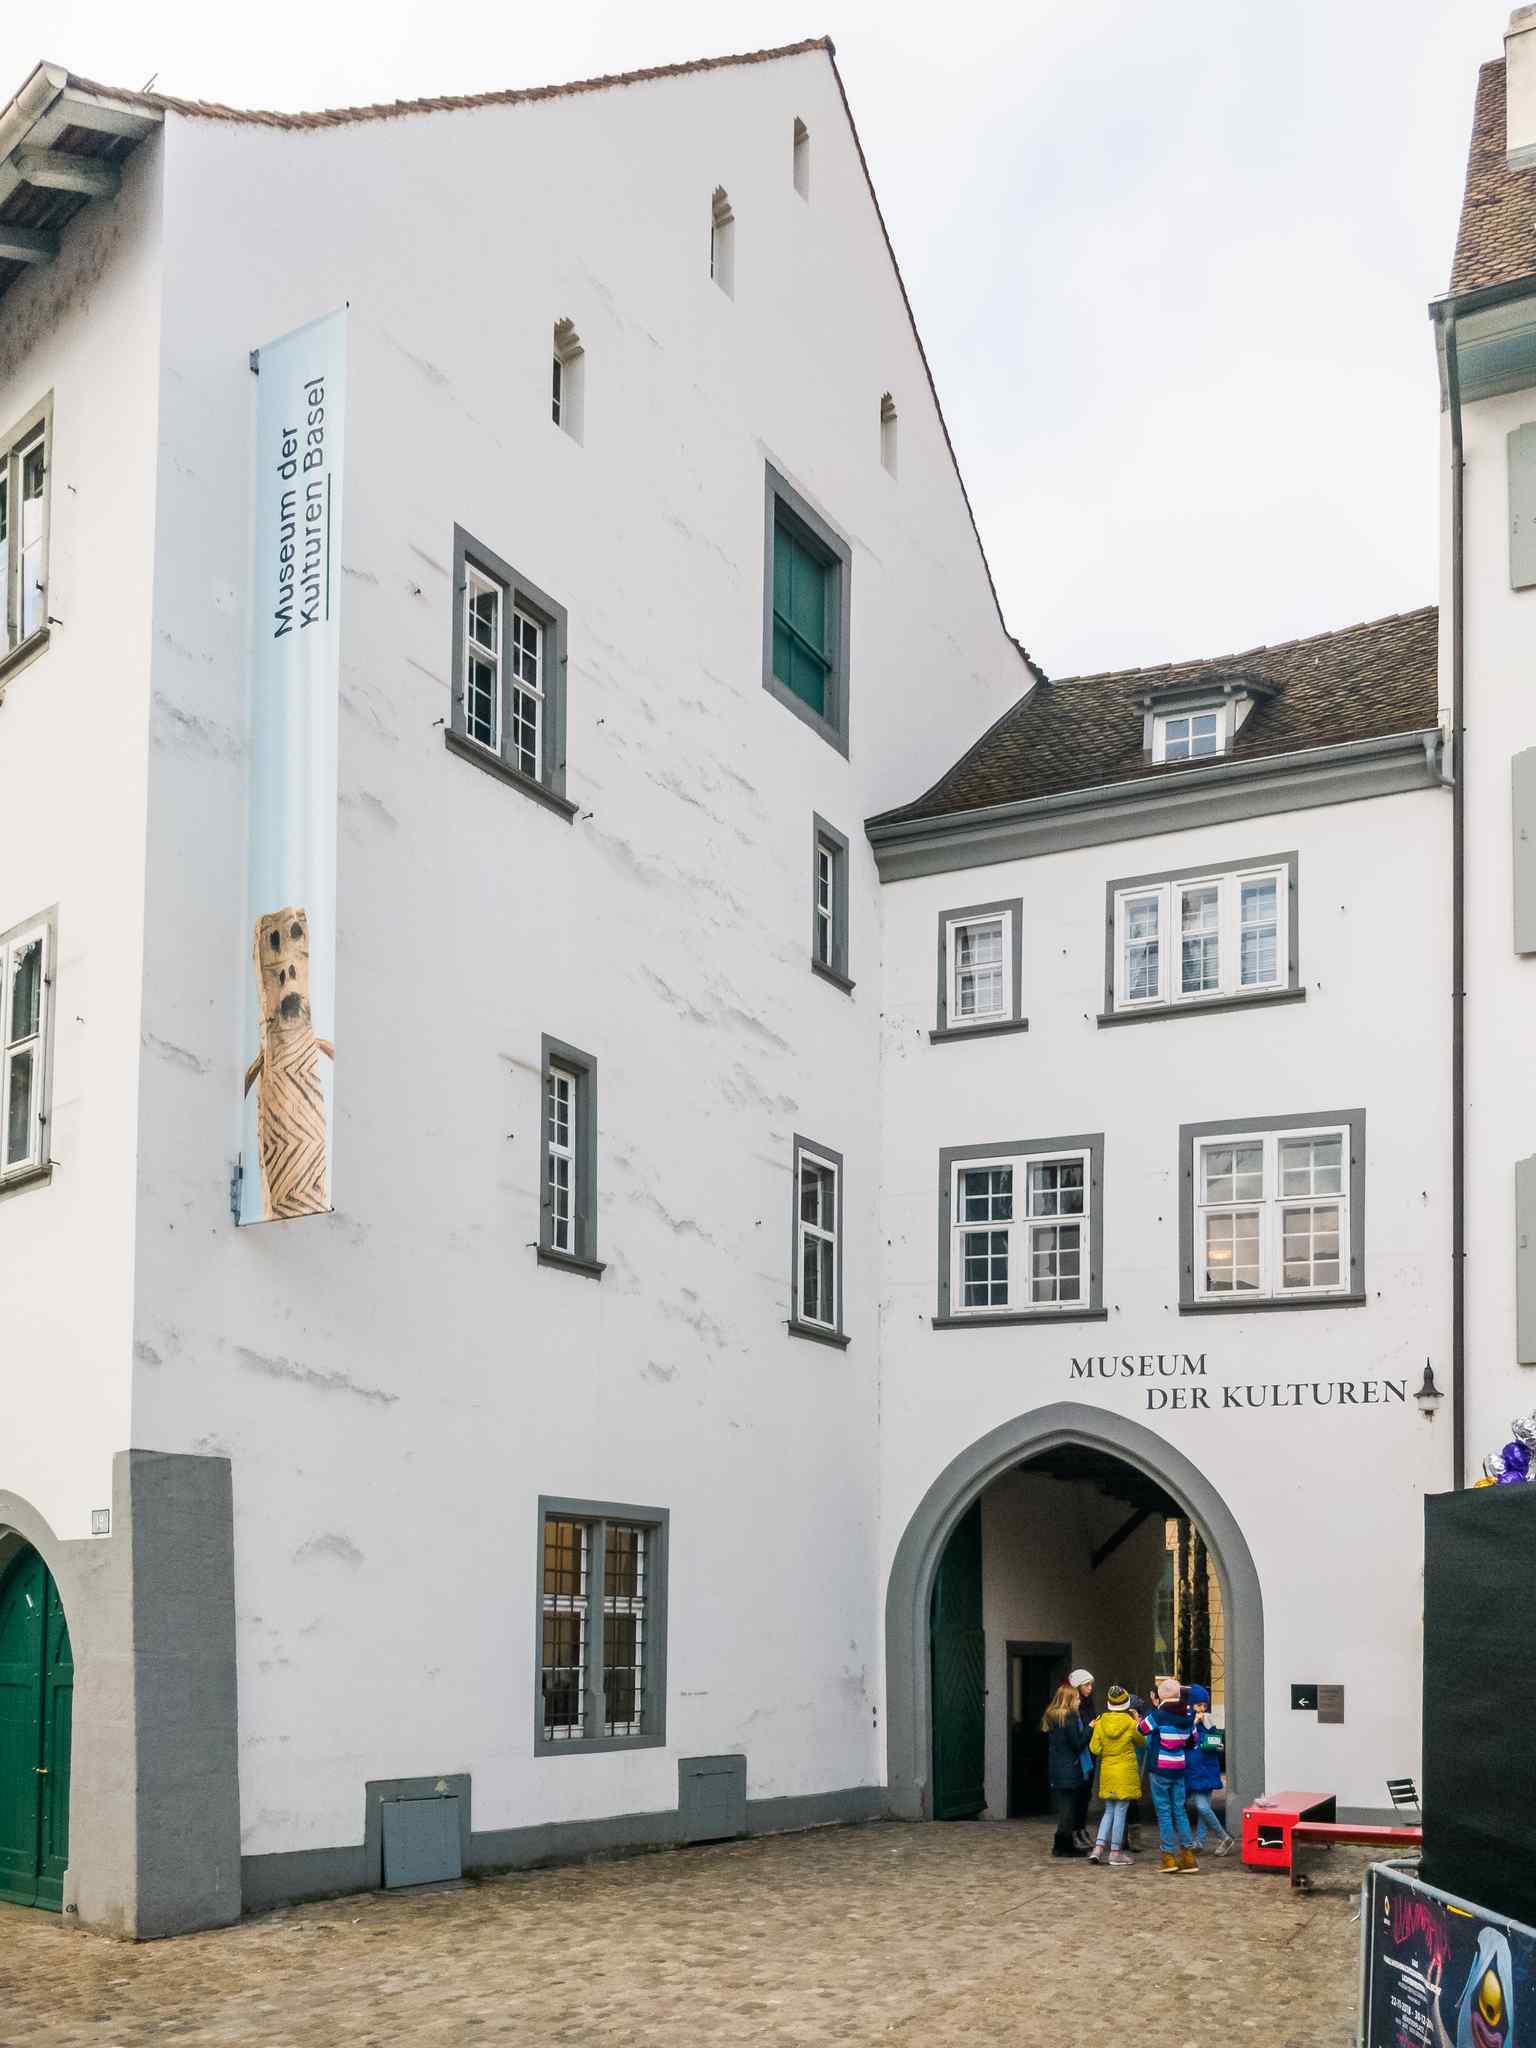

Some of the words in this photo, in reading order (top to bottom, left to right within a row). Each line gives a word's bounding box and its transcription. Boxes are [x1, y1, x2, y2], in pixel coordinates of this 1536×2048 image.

[277, 427, 298, 480] der
[303, 376, 325, 472] Basel
[273, 490, 297, 638] Museum
[300, 481, 323, 629] Kulturen
[1069, 1353, 1208, 1379] MUSEUM
[1146, 1387, 1211, 1410] DER
[1222, 1379, 1408, 1409] KULTUREN
